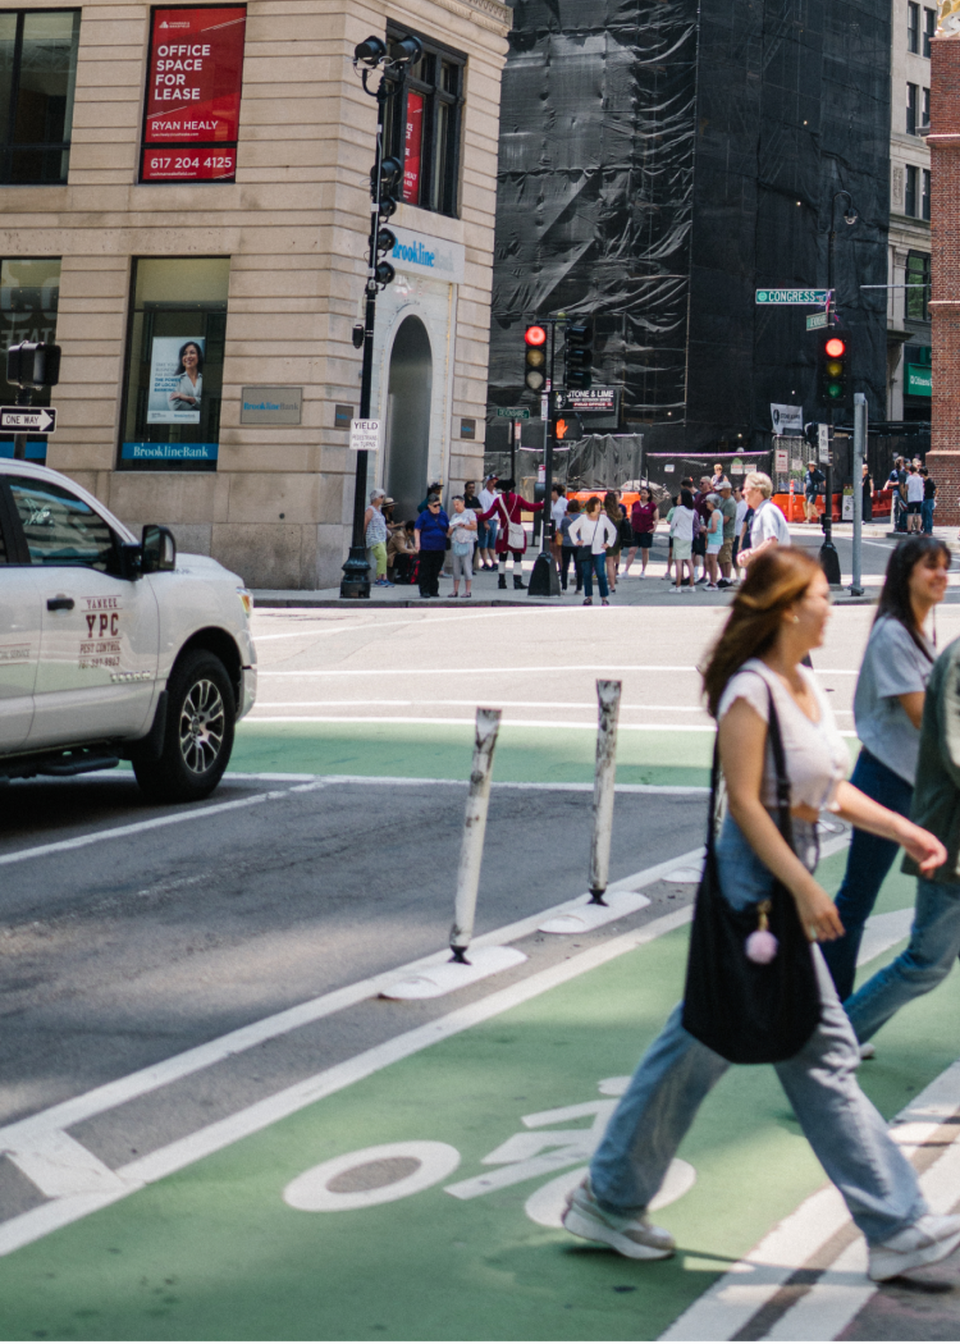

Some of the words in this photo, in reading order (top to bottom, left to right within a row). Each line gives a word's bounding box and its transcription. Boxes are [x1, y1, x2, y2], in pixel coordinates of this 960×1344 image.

[158, 45, 210, 56] OFFICE
[156, 59, 202, 71] SPACE
[156, 74, 186, 86] FOR
[154, 88, 200, 100] LEASE
[152, 121, 180, 130] RYAN
[184, 120, 218, 130] HEALY
[150, 158, 171, 168] 617
[174, 158, 199, 168] 204
[203, 157, 232, 168] 4125
[768, 291, 815, 302] CONGRESS
[6, 415, 21, 424] ONE
[24, 416, 39, 424] WAY
[354, 422, 378, 430] YIELD
[134, 446, 208, 457] BrooklineBank
[86, 598, 118, 609] YANKEE
[86, 613, 119, 638] YPC
[80, 643, 94, 654] PEST
[95, 640, 121, 653] CONTROL
